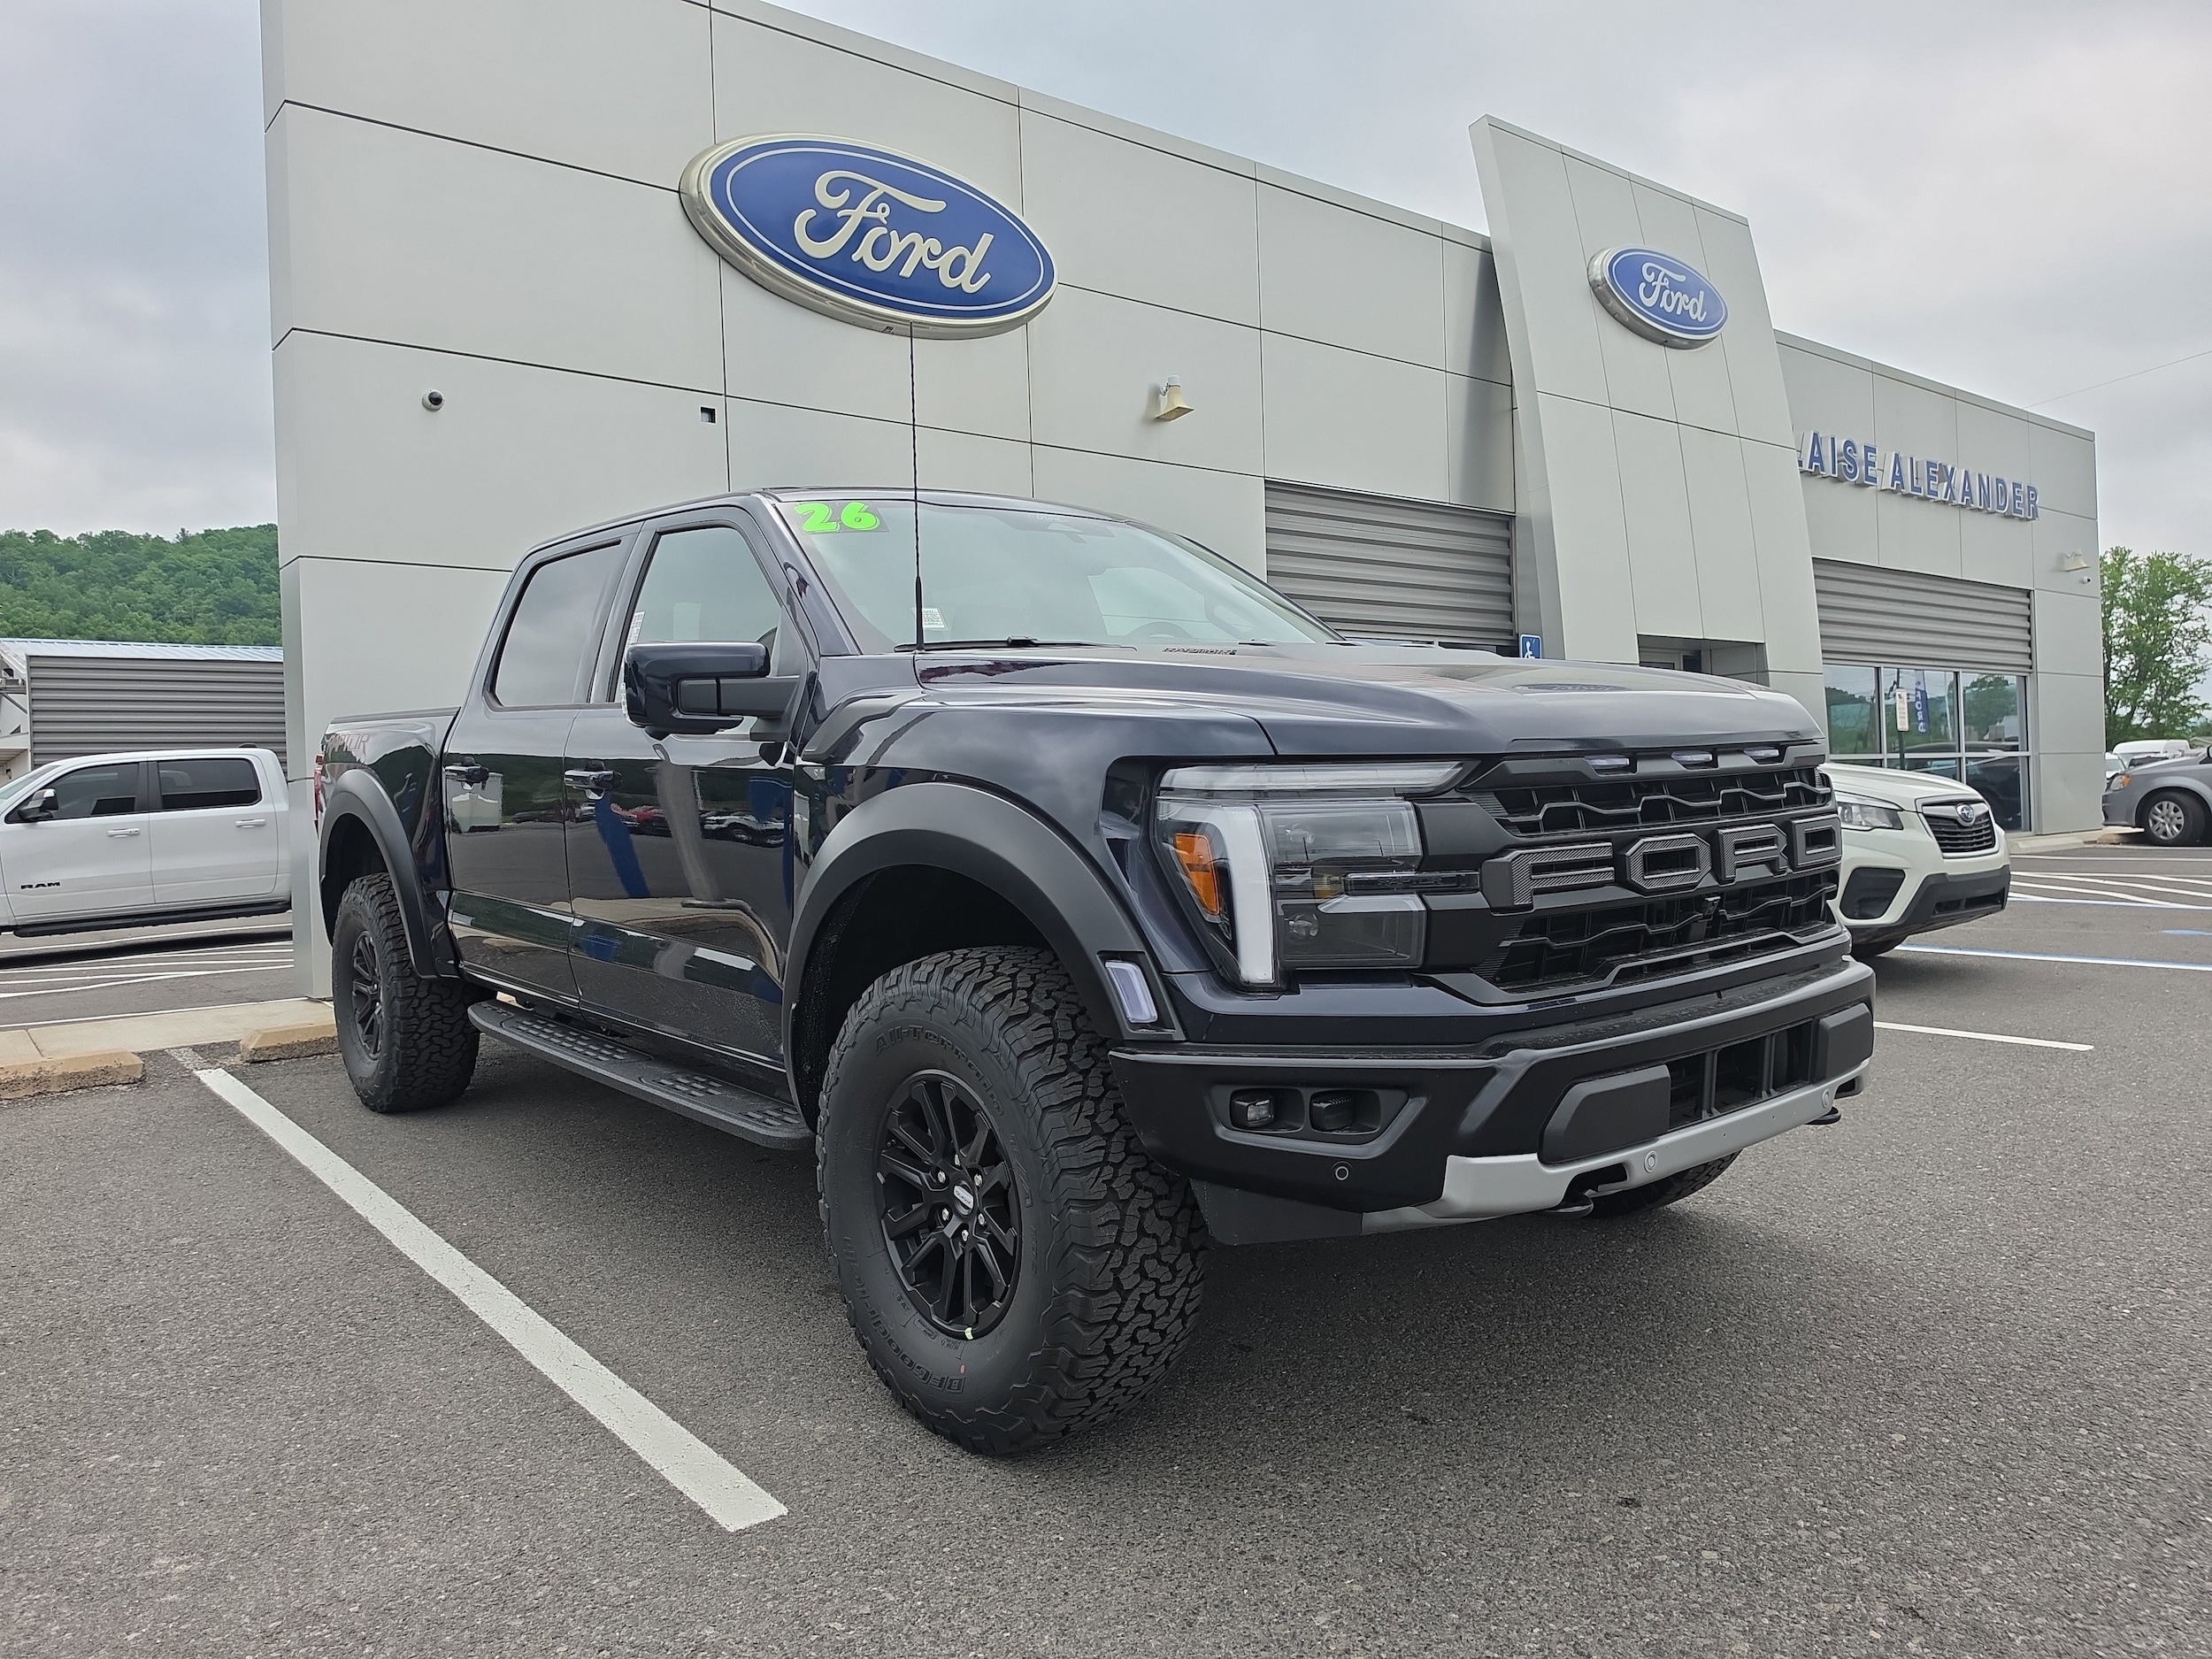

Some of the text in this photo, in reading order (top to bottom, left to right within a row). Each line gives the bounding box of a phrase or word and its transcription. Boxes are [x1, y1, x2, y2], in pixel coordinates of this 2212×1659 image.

[794, 170, 995, 294] Ford
[1639, 263, 1707, 322] Ford
[795, 502, 880, 533] 26
[1798, 430, 2039, 520] AISE ALEXANDER
[20, 881, 61, 890] RAM
[1508, 814, 1842, 908] FORD
[876, 1024, 1004, 1117] All-Terrain
